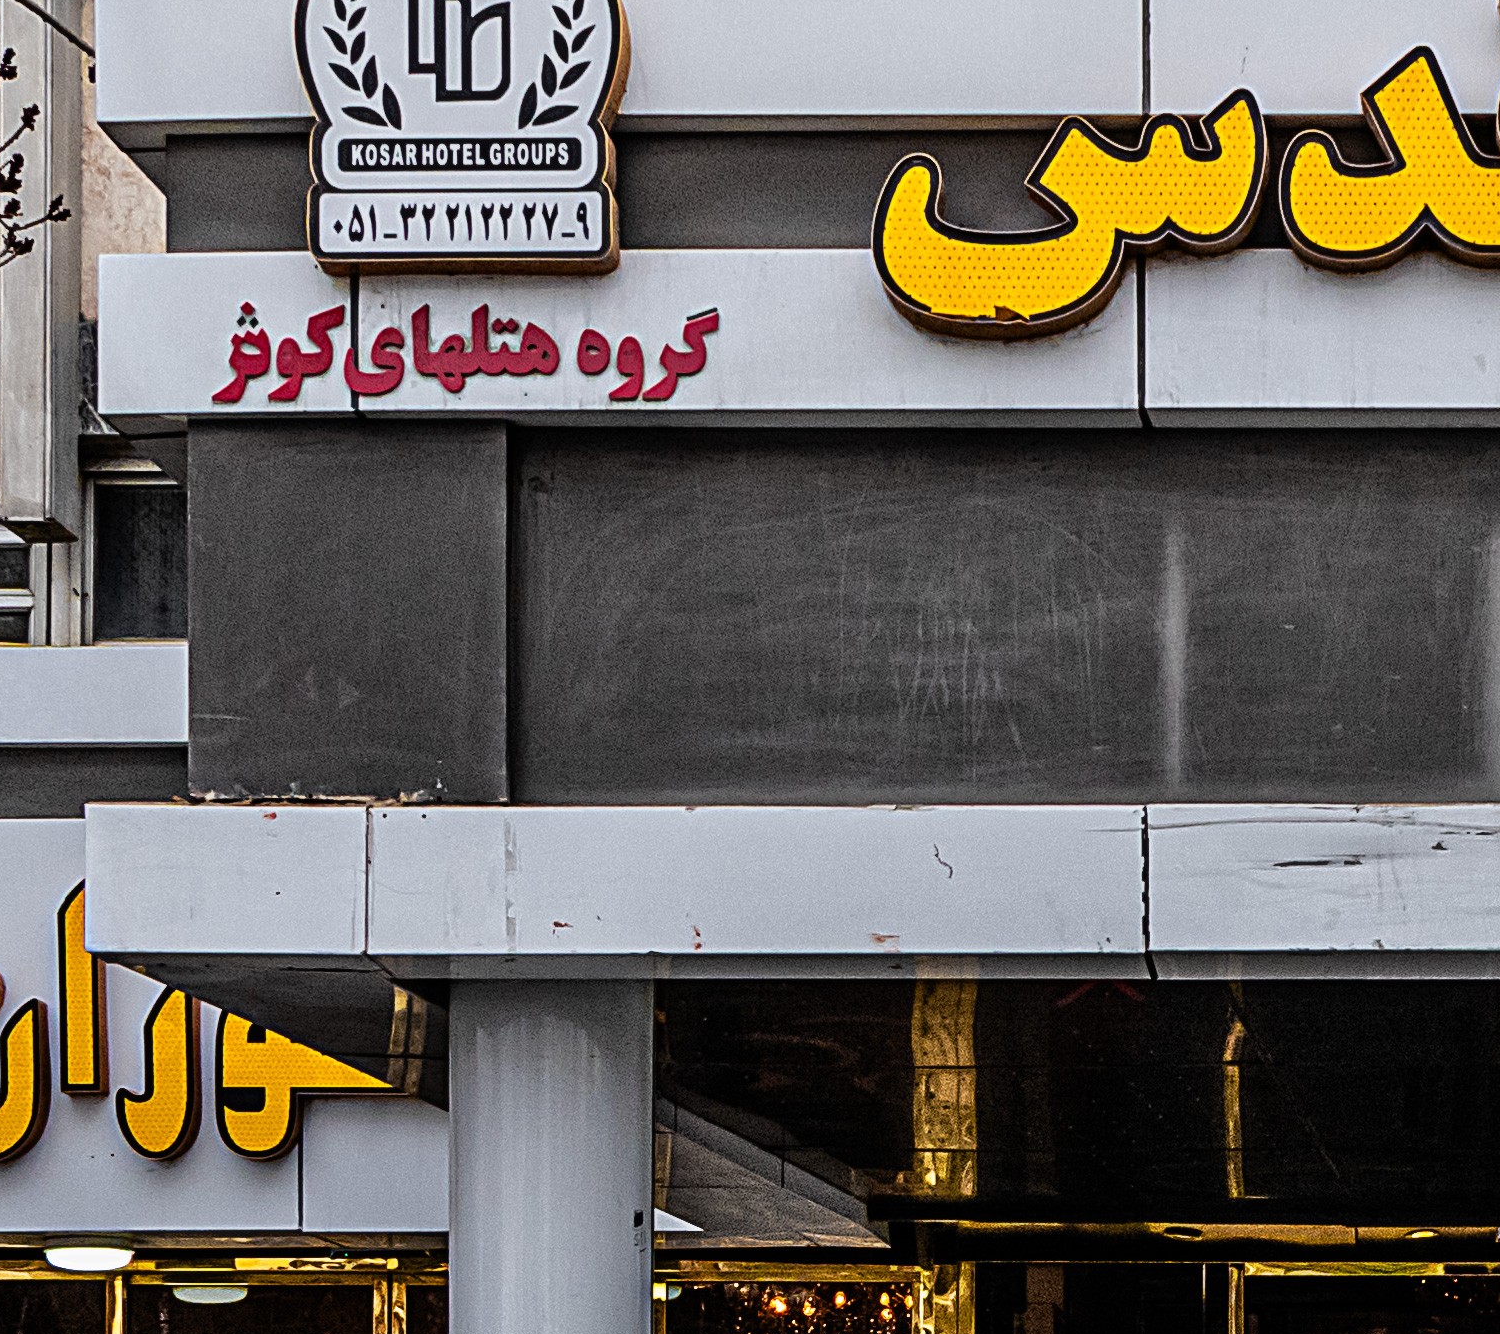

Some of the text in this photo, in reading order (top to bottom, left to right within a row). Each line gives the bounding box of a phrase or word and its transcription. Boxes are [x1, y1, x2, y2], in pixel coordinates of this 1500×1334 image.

[350, 142, 570, 166] KOSAR HOTEL GROUPS
[211, 300, 720, 404] گروه هتلهای کوثر
